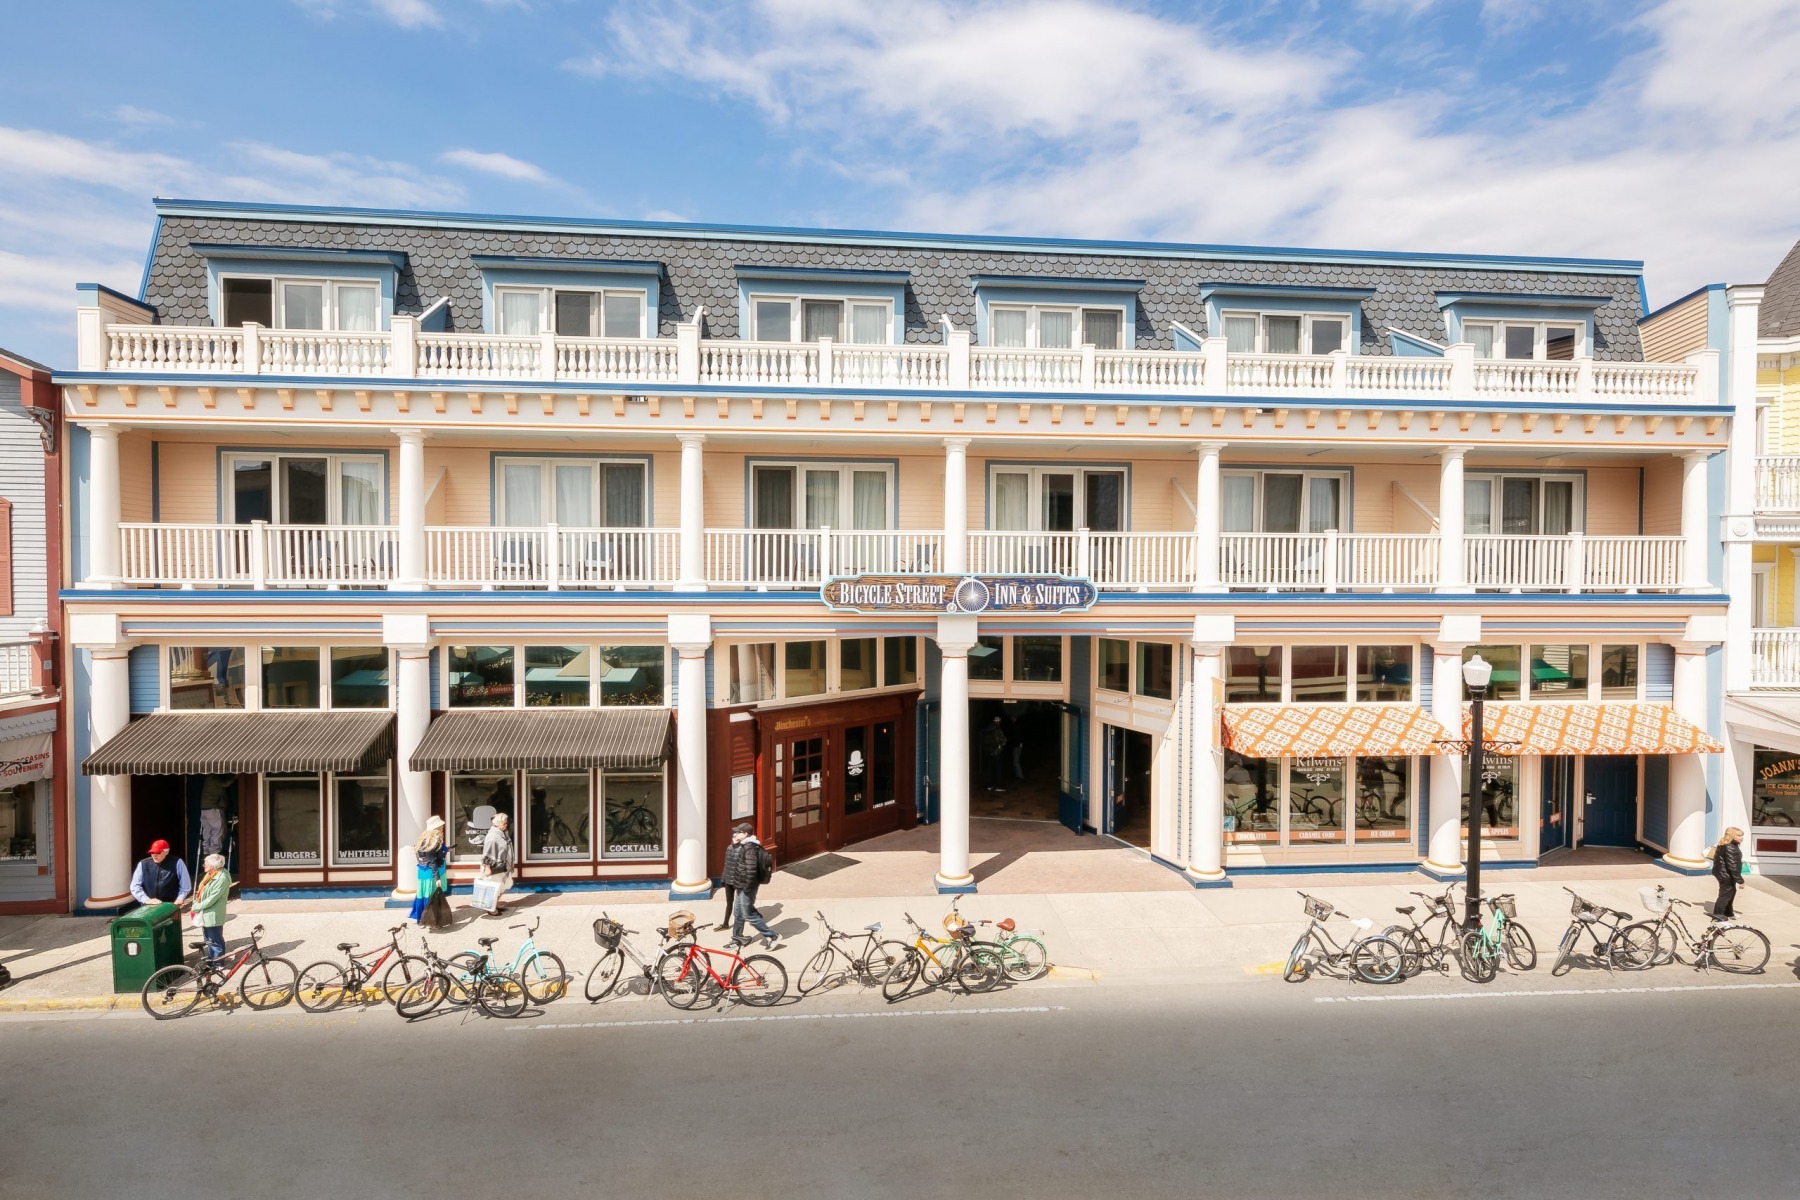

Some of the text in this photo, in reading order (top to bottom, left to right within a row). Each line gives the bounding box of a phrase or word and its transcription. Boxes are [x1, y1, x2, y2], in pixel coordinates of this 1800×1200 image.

[840, 582, 1080, 605] BICYCLE STREET INN & SUITES
[1296, 756, 1342, 767] Kilwins
[541, 845, 578, 854] STEAKS
[609, 843, 660, 853] COCKTAILS
[273, 851, 318, 859] BURGERS
[338, 849, 391, 858] WHITEFISH
